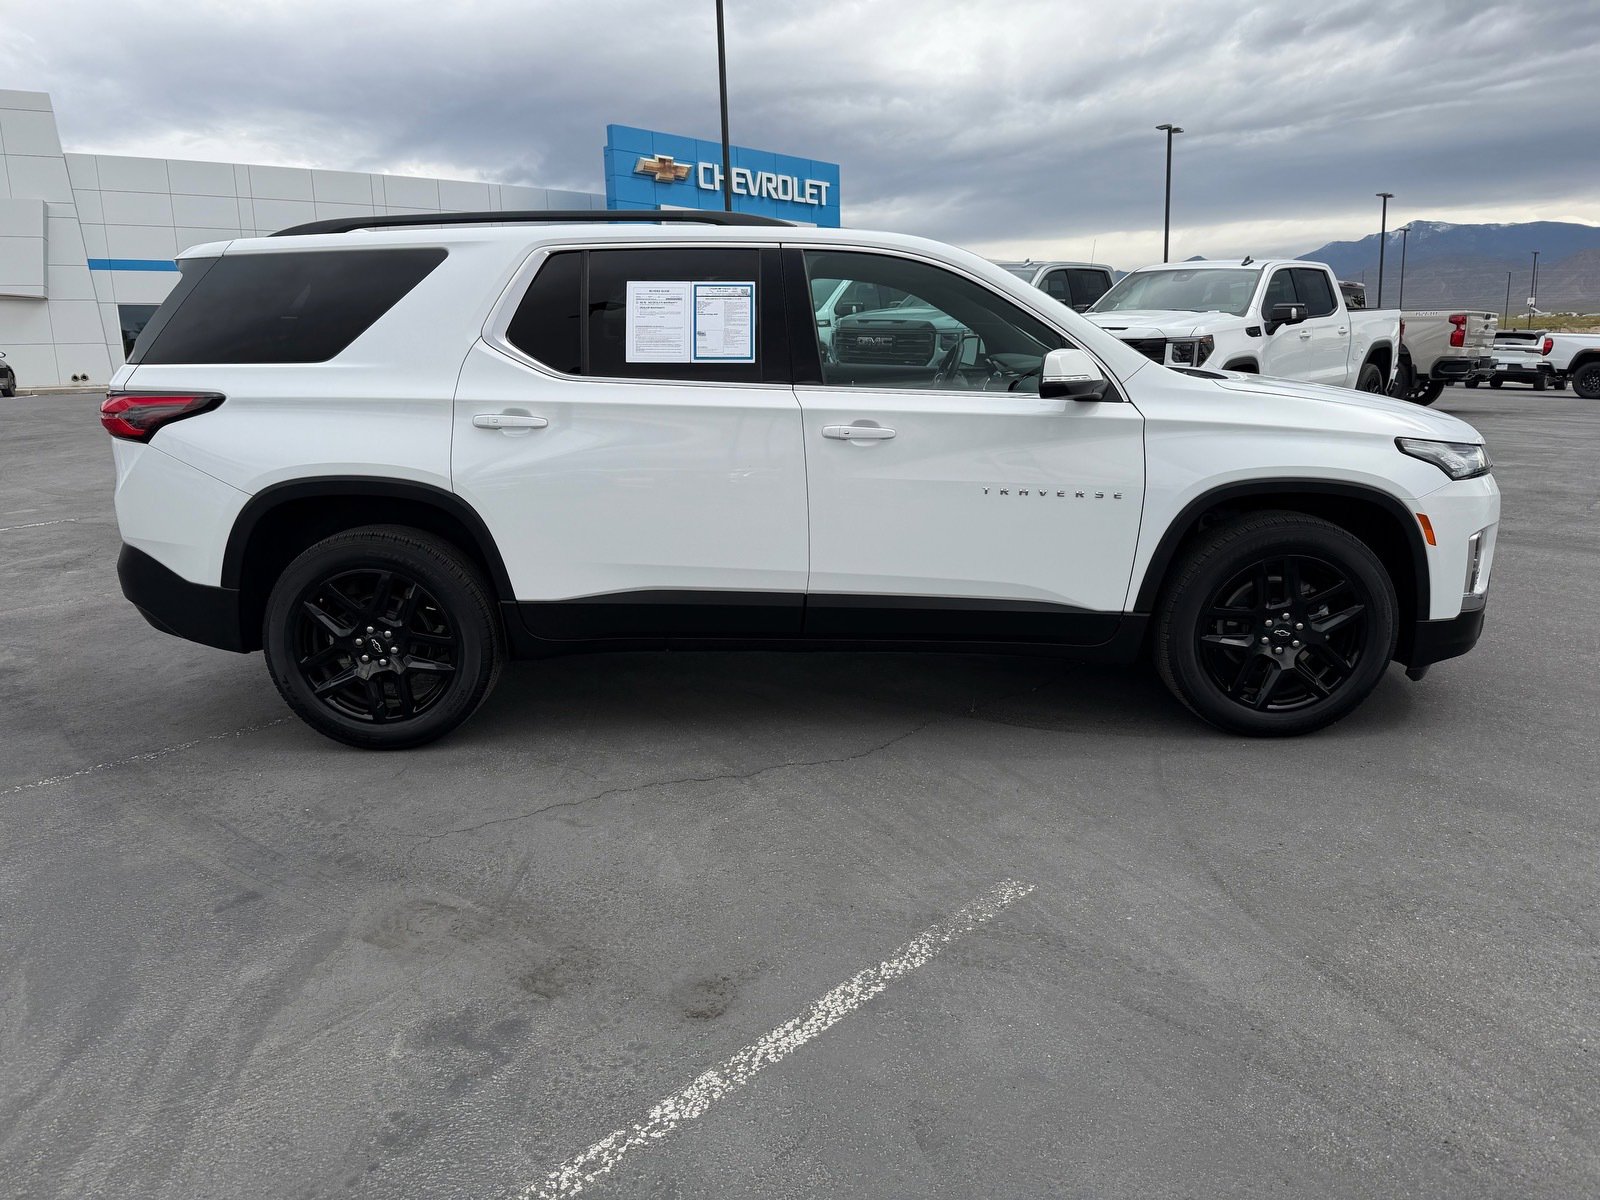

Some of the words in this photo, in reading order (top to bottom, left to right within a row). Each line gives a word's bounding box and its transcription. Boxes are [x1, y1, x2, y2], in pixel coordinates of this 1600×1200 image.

[698, 161, 830, 206] CHEVROLET
[856, 336, 893, 346] GMC
[982, 487, 1123, 500] TRAVERSE
